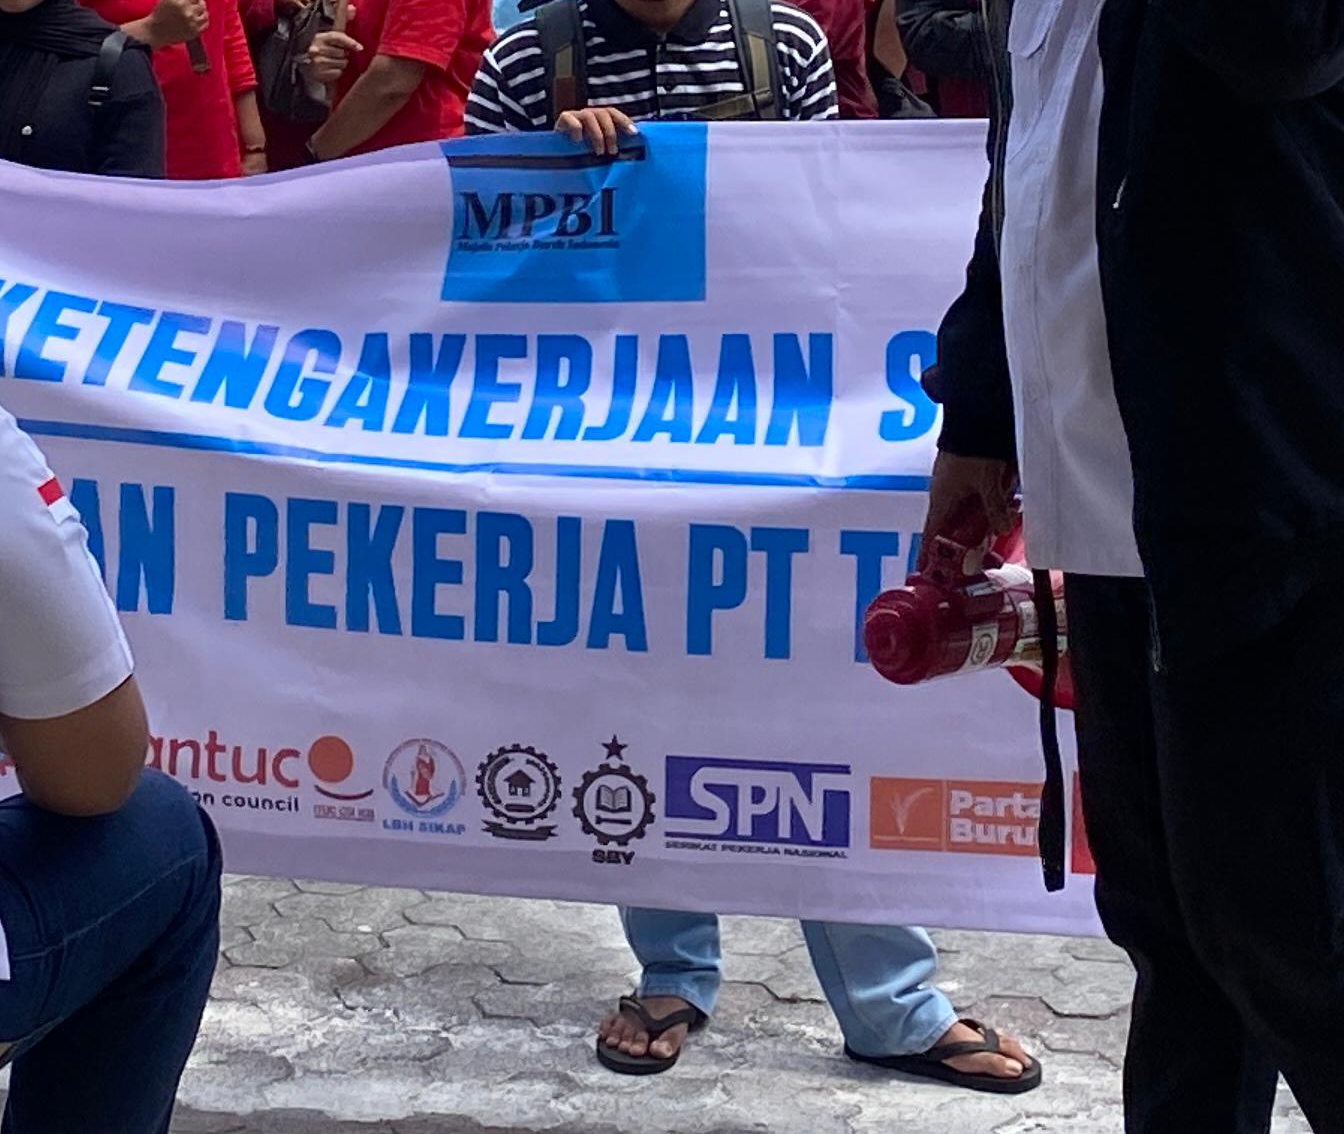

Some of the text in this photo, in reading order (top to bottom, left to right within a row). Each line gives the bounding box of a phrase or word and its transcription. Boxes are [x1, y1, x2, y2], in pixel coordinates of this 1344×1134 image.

[458, 186, 620, 240] MPBI
[879, 330, 939, 442] S
[223, 491, 649, 653] PEKERJA
[686, 522, 811, 662] PT
[221, 794, 300, 813] council
[668, 765, 850, 842] SPN
[950, 789, 1041, 818] Parta
[382, 819, 414, 831] LBH
[418, 821, 466, 836] SIKAP
[950, 817, 1035, 846] Buru
